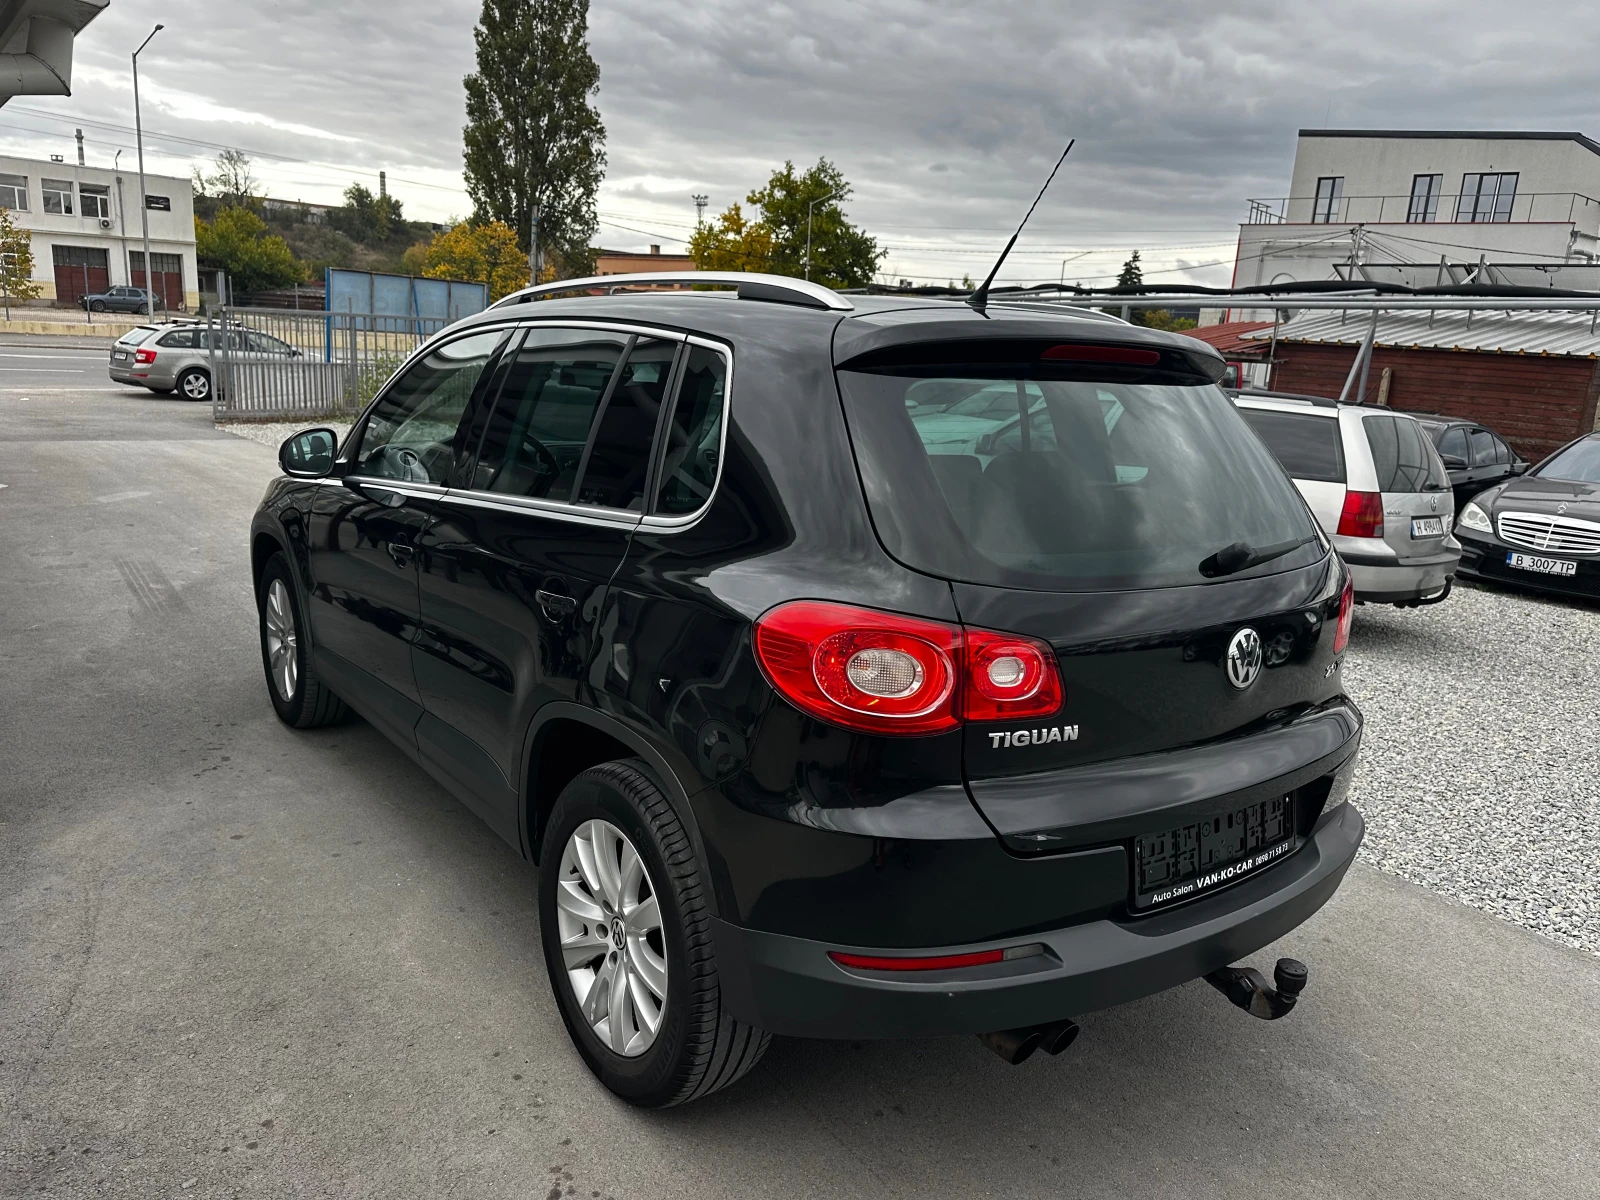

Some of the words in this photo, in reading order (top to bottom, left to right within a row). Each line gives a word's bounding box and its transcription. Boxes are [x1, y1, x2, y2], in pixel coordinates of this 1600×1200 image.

[1516, 555, 1523, 566] B
[1528, 557, 1557, 571] 3007
[1559, 561, 1575, 573] TP
[988, 724, 1079, 749] TIGUAN
[1151, 891, 1172, 904] Auto
[1172, 884, 1194, 897] Salon
[1196, 858, 1253, 889] VAN-KO-CAR
